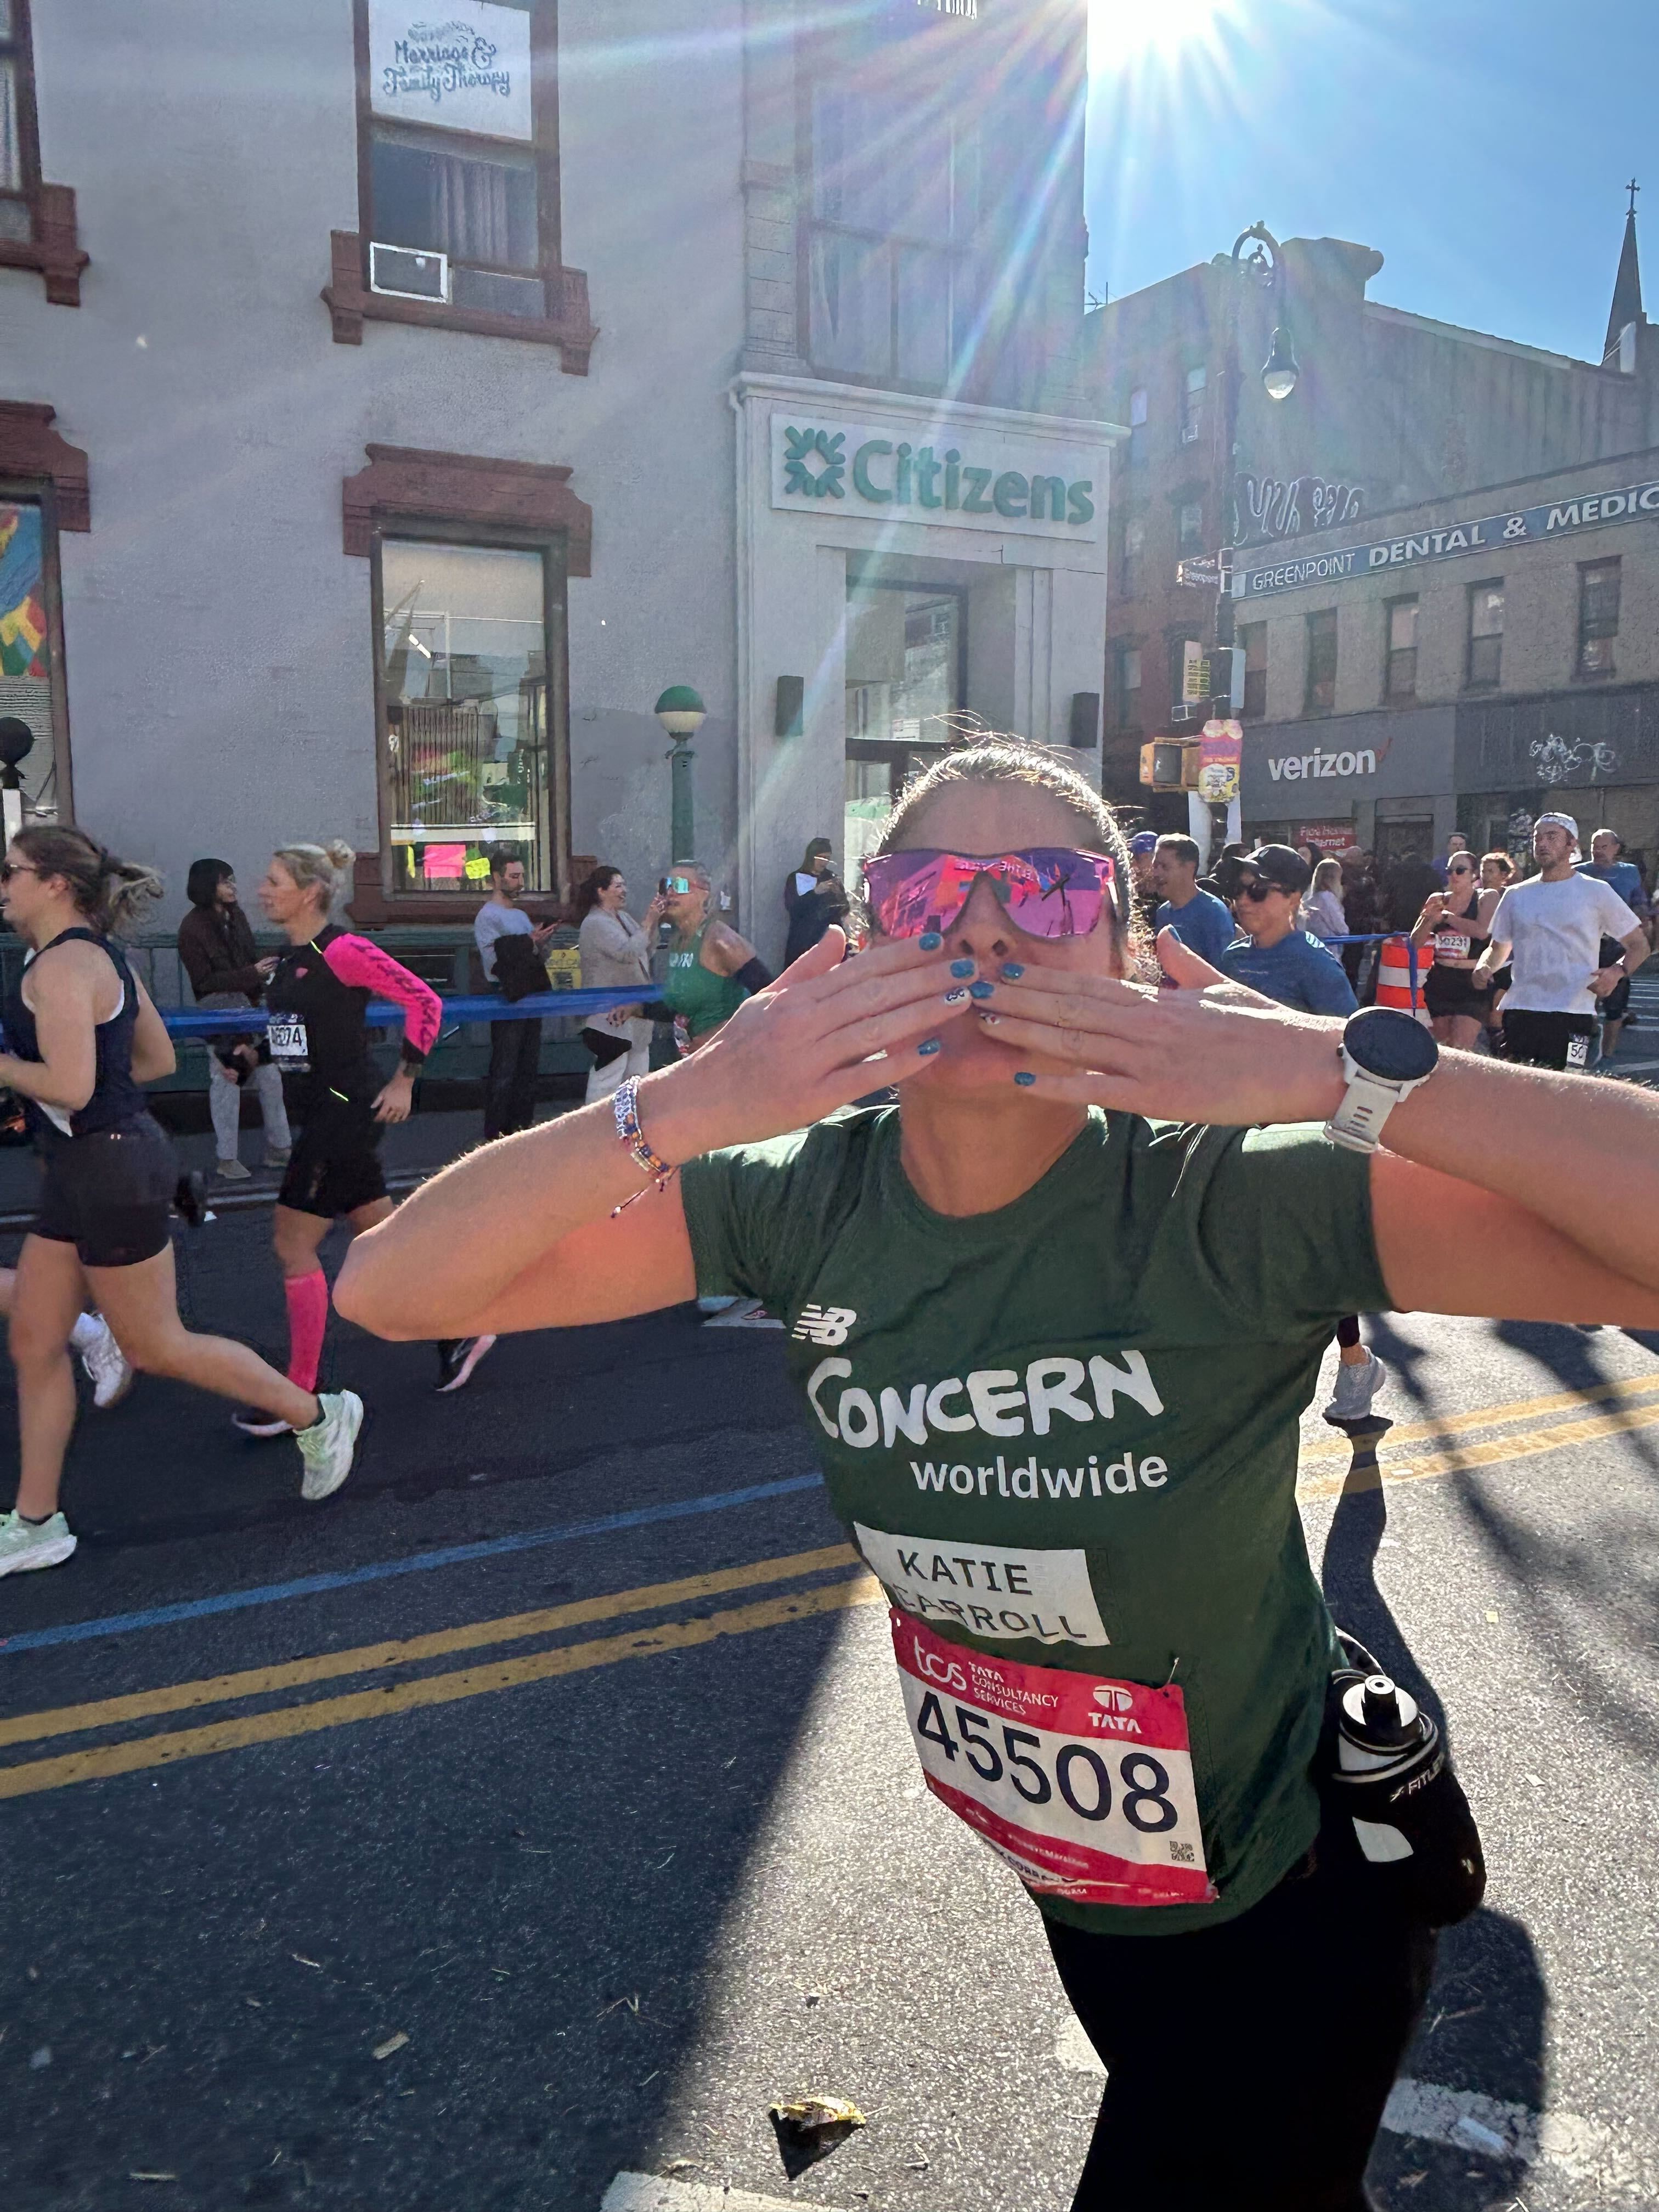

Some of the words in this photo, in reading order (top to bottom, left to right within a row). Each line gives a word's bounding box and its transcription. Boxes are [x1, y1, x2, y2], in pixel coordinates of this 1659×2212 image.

[853, 439, 1095, 525] Citizens
[1252, 553, 1356, 591] GREENPOINT
[1369, 525, 1486, 567] DENTAL
[1503, 517, 1527, 539] &
[1268, 747, 1376, 781] verizon
[806, 1349, 1165, 1448] CONCERN
[909, 1451, 1169, 1499] worldwide
[897, 1549, 1033, 1596] KATIE
[892, 1583, 1087, 1639] CARROLL
[913, 1635, 967, 1691] tcs
[968, 1661, 1005, 1683] TATA
[971, 1674, 1059, 1708] CONSULTANCY
[973, 1687, 1026, 1716] SERVICES
[1087, 1712, 1142, 1734] TATA
[917, 1690, 1178, 1833] 45508
